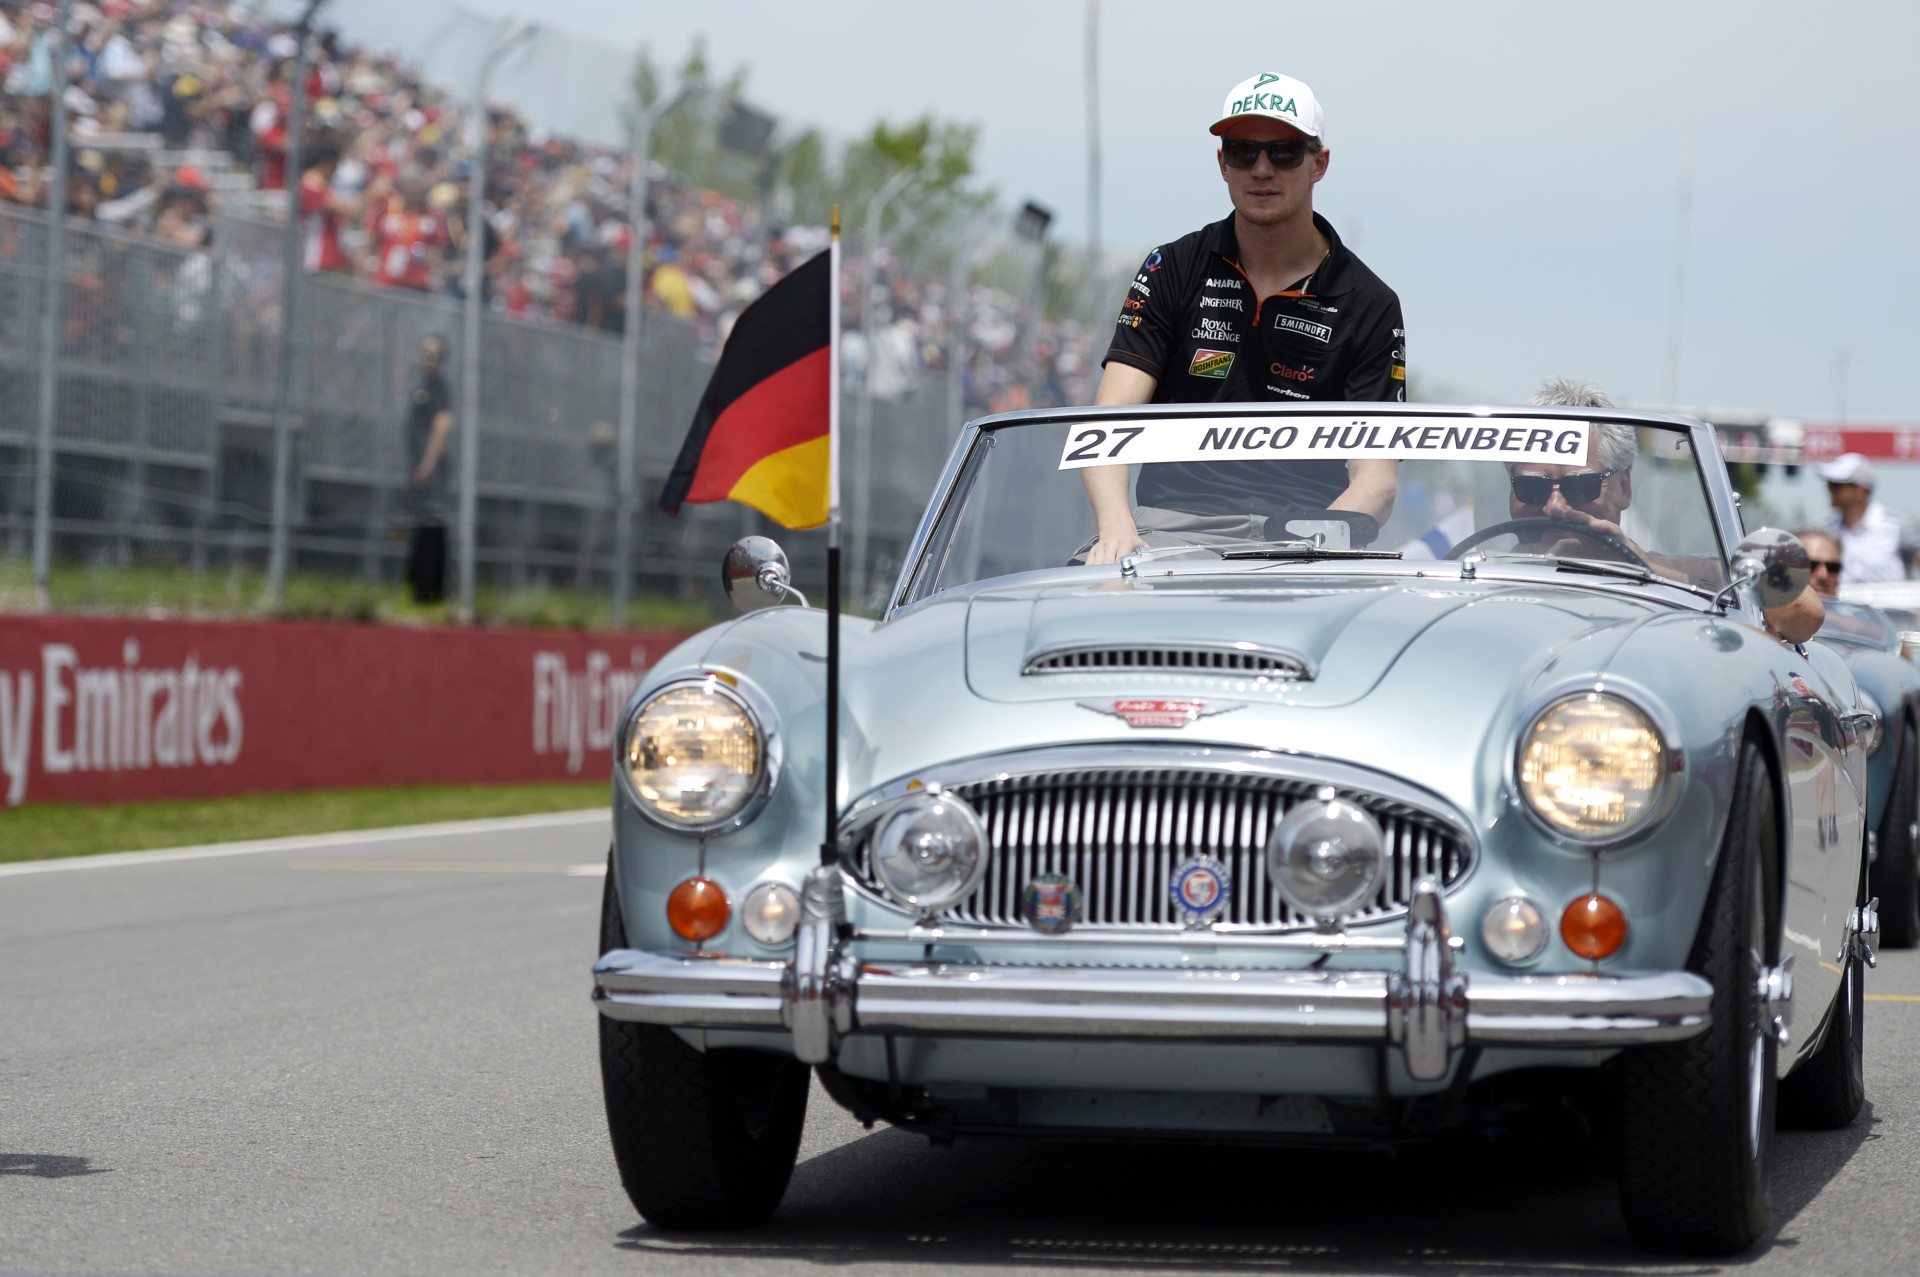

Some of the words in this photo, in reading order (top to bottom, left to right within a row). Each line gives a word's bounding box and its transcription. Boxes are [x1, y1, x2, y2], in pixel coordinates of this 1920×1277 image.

[1231, 92, 1298, 117] DEKRA
[1191, 327, 1241, 343] CHALLENGE
[1201, 317, 1233, 332] ROYAL
[1270, 362, 1308, 381] Claro
[1065, 427, 1145, 461] 27
[1198, 426, 1299, 450] NICO
[1308, 421, 1583, 454] HÜLKENBERG
[41, 636, 244, 773] Emirates
[532, 651, 586, 774] Fly
